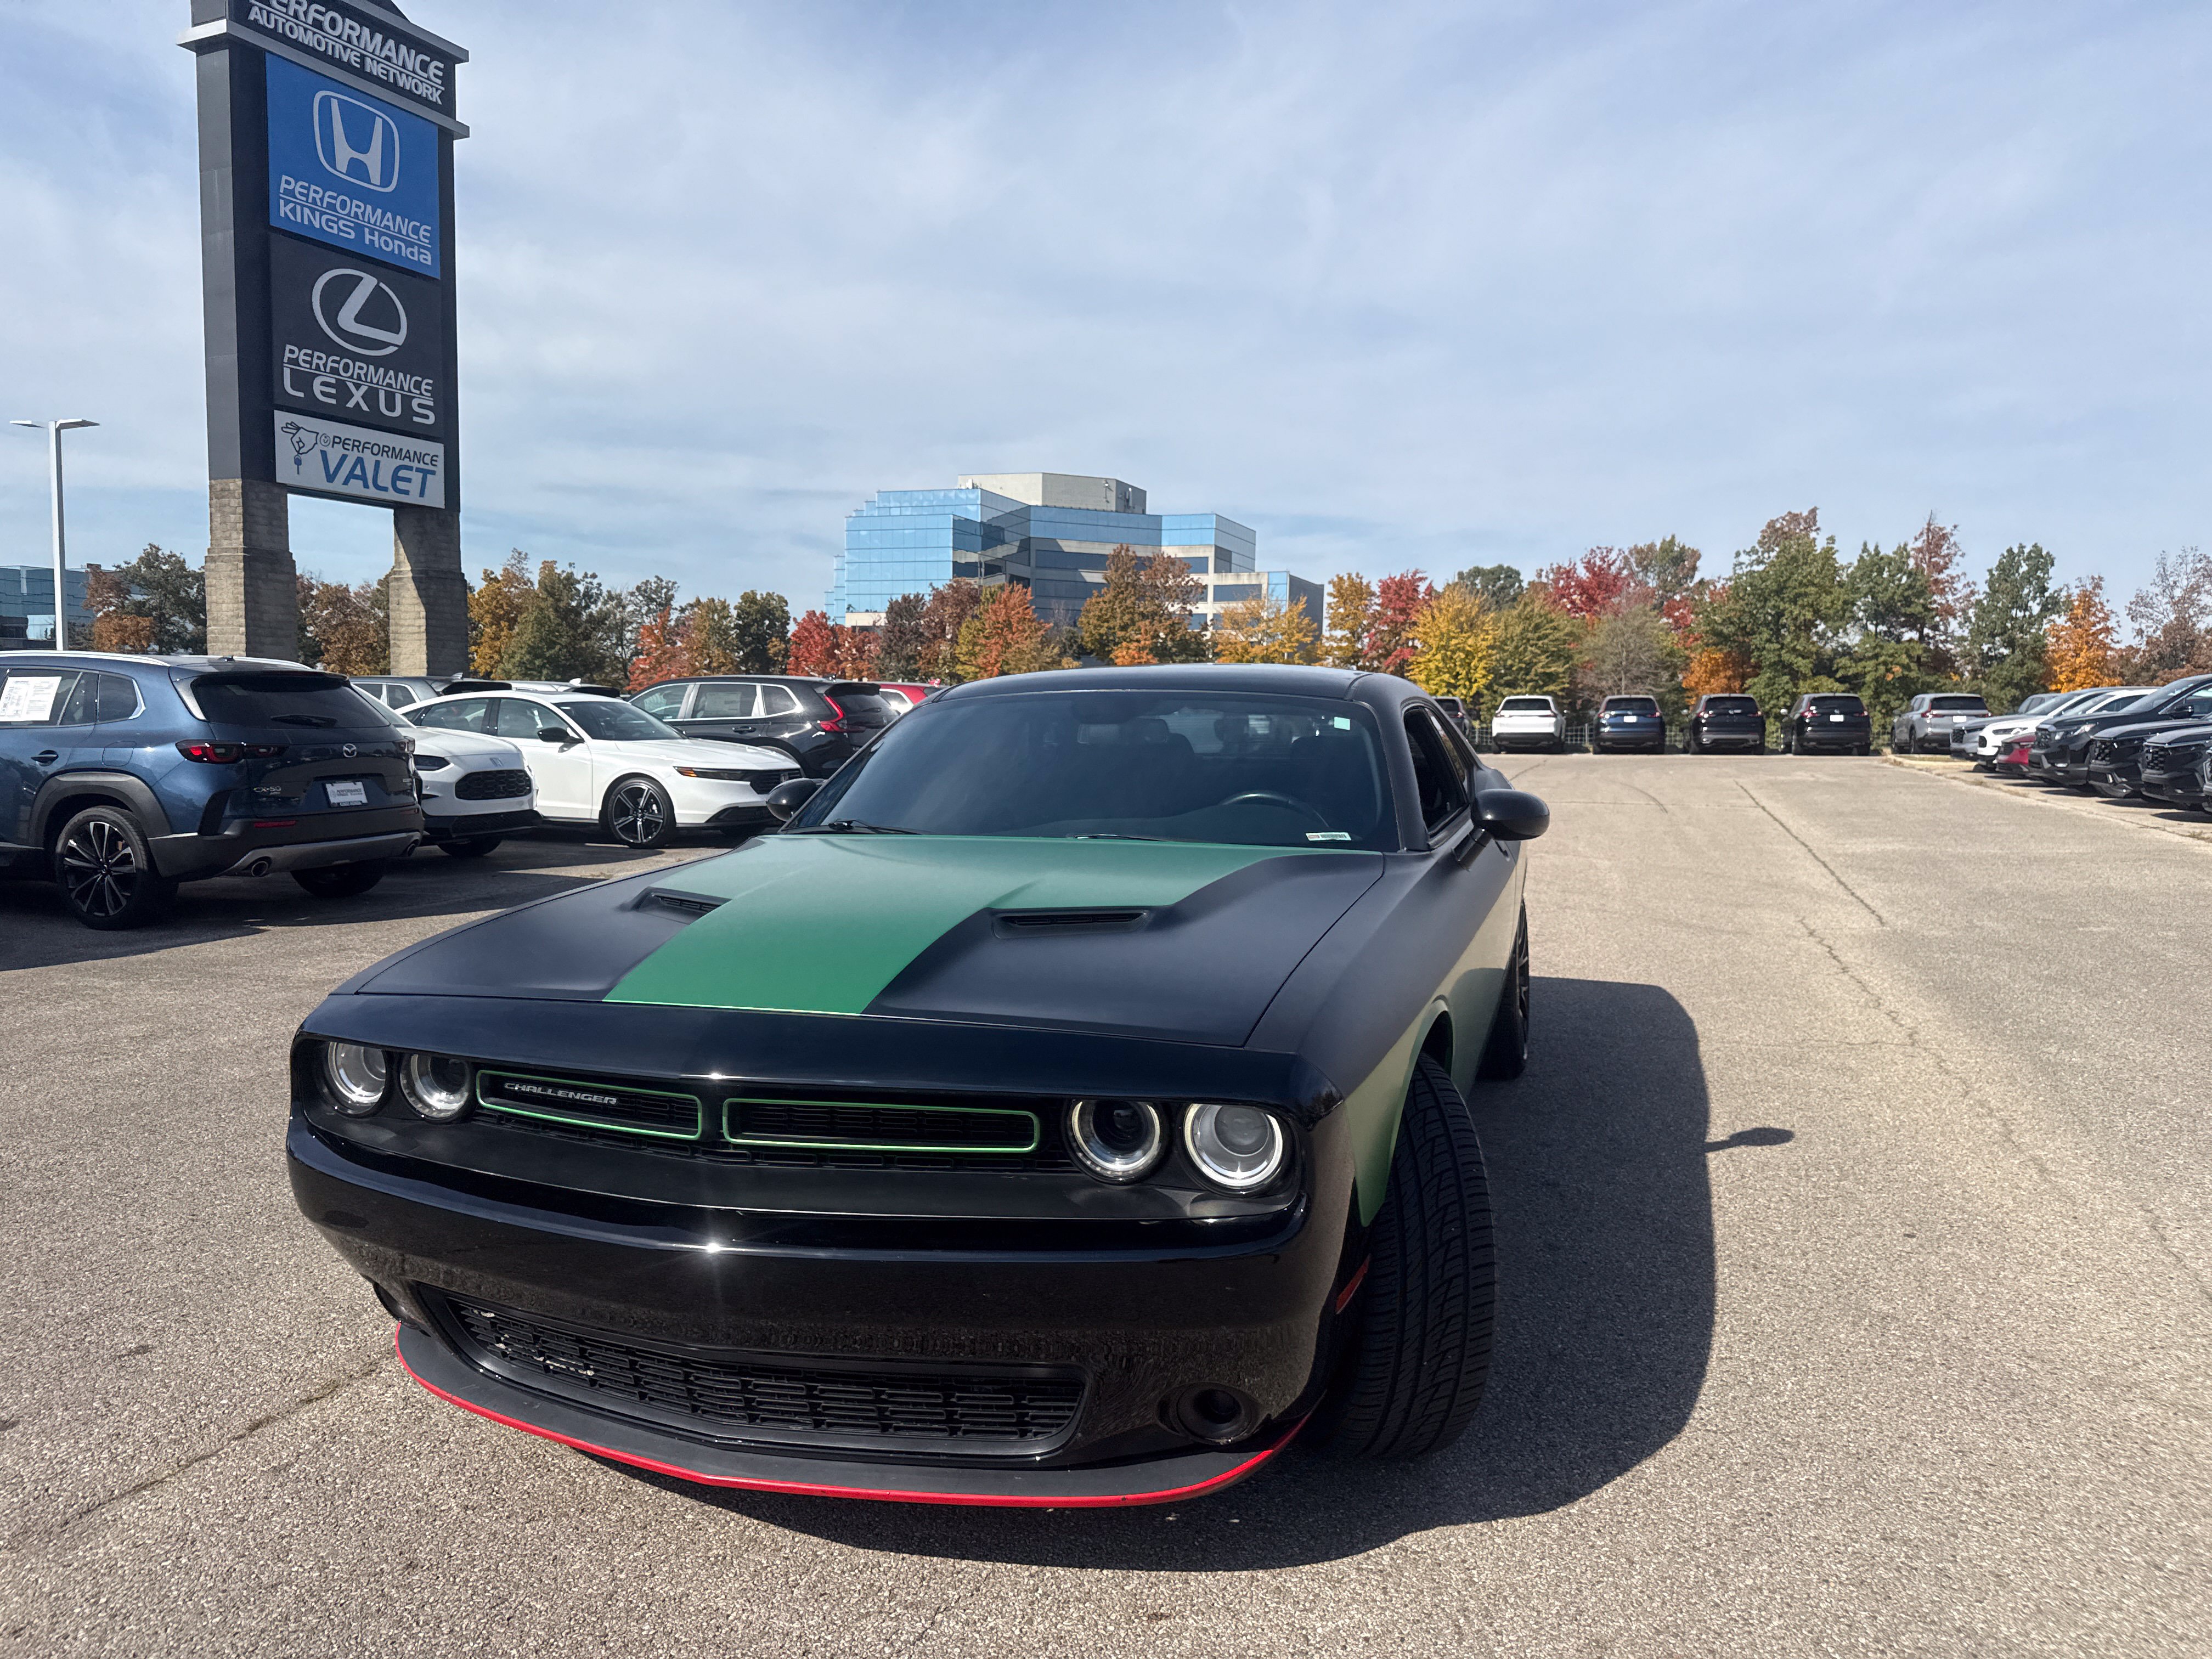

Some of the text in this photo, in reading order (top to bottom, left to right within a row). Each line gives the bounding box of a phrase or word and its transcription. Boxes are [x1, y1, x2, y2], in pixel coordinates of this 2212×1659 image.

[247, 5, 442, 105] AUTOMOTIVE NETWORK
[269, 0, 444, 85] ERFORMANCE
[279, 174, 431, 243] PERFORMANCE
[279, 199, 432, 266] KINGS Honda
[283, 343, 433, 397] PERFORMANCE
[283, 366, 436, 425] LEXUS
[320, 449, 436, 498] VALET
[331, 435, 438, 466] PERFORMANCE
[504, 1082, 617, 1105] CHALLENGER
